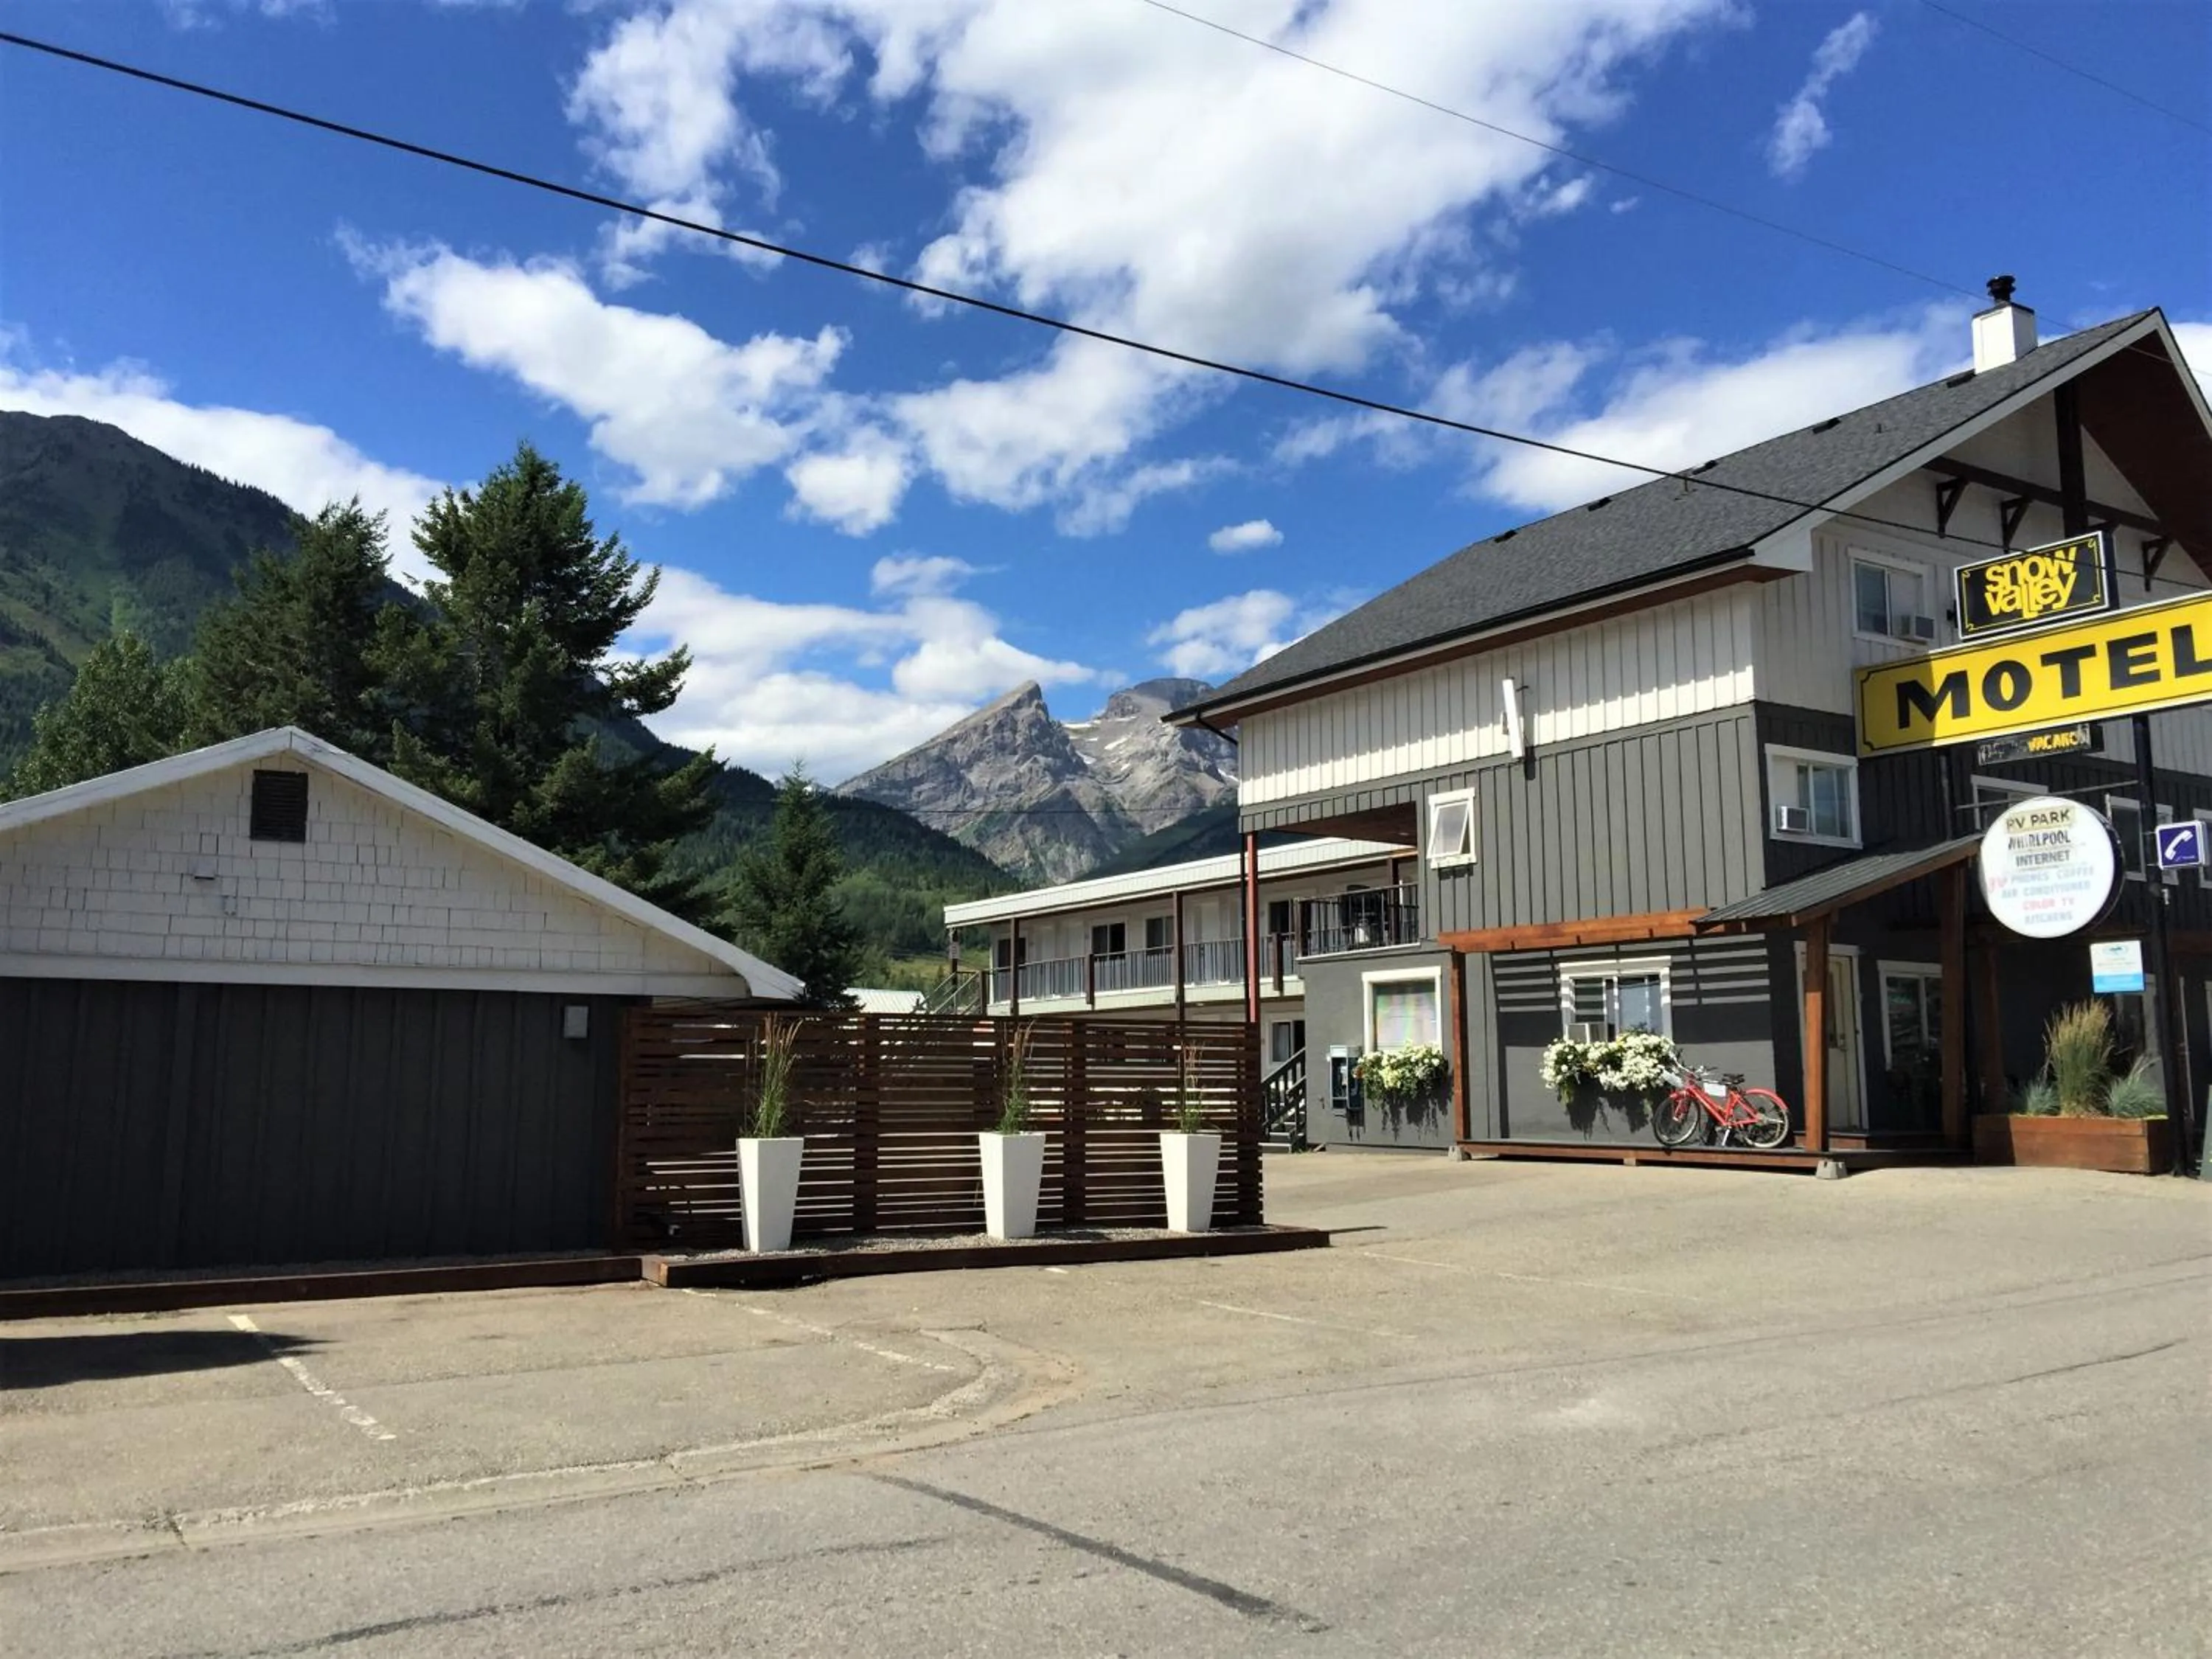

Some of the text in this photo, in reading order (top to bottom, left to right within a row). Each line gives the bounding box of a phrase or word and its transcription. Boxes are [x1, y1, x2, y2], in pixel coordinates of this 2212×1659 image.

[1896, 625, 2212, 729] MOTEL
[2030, 809, 2070, 827] PARK
[2008, 830, 2071, 849] WHIRLPOOL
[2016, 849, 2070, 867] INTERNET
[2023, 898, 2056, 911] COLOR
